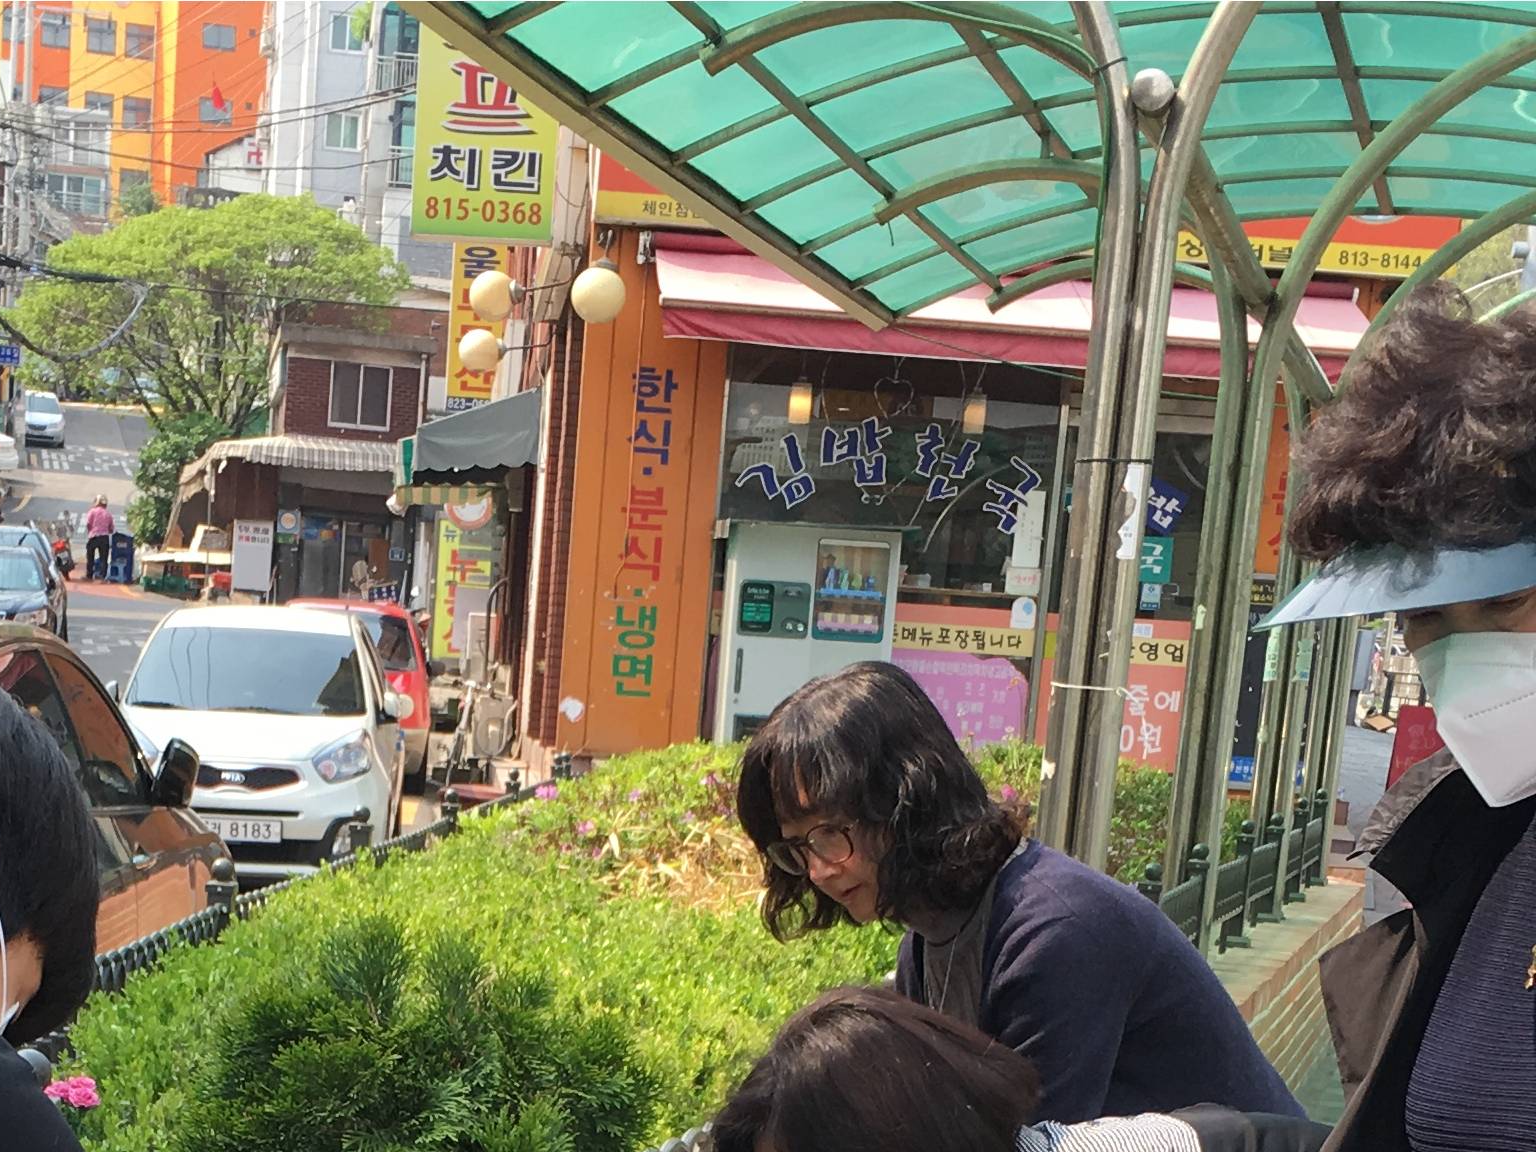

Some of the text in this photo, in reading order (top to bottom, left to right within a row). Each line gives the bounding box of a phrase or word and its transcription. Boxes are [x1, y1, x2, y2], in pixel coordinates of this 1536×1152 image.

[430, 145, 543, 194] 치킨
[424, 195, 543, 227] 815-0368
[1131, 642, 1184, 663] 영업
[229, 822, 272, 840] 8183
